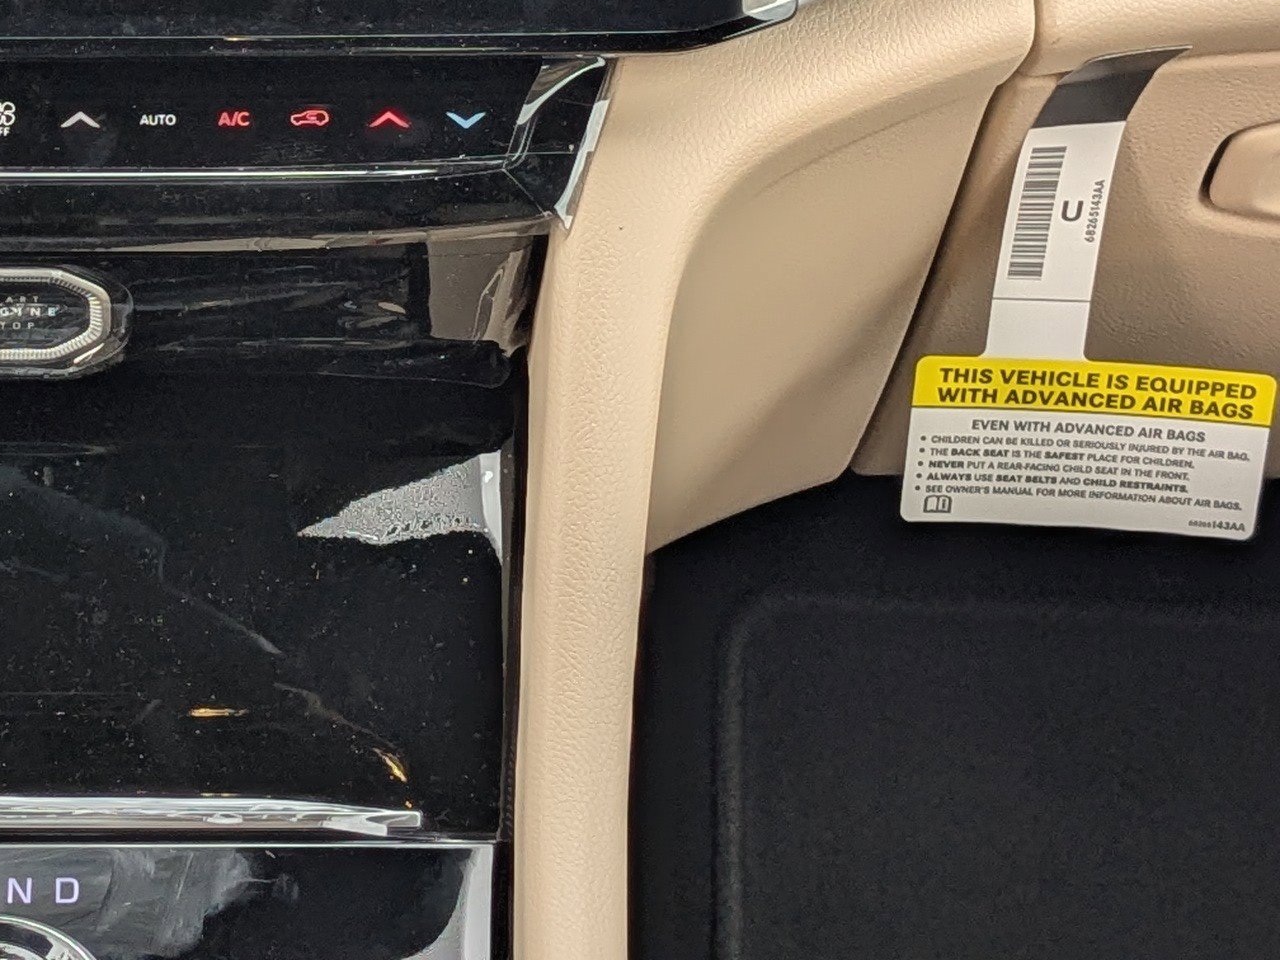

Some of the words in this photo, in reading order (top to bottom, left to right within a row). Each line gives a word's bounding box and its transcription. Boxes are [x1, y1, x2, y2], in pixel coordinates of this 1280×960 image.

[140, 113, 177, 126] AUTO
[219, 111, 250, 127] A/C
[939, 367, 993, 384] THIS
[1000, 369, 1101, 388] VEHICLE
[1106, 374, 1130, 390] IS
[1135, 376, 1257, 400] EQUIPPED
[937, 387, 998, 403] WITH
[1004, 390, 1136, 410] ADVANCED
[1141, 396, 1183, 414] AIR
[1189, 400, 1255, 420] BAGS
[971, 419, 1009, 431] EVEN
[1013, 420, 1051, 433] WITH
[1053, 422, 1135, 437] ADVANCED
[1137, 427, 1163, 440] AIR
[1166, 429, 1206, 442] BAGS
[930, 448, 948, 456] THE
[951, 448, 980, 457] BACK
[983, 449, 1009, 458] SEAT
[1012, 450, 1021, 458] IS
[1023, 450, 1042, 459] THE
[1044, 451, 1086, 461] SAFEST
[1087, 454, 1118, 463] PLACE
[1120, 455, 1140, 464] FOR
[931, 435, 980, 445] CHILDREN
[982, 436, 1003, 446] CAN
[1006, 437, 1018, 446] BE
[1021, 437, 1054, 447] KILLED
[1056, 438, 1070, 447] OR
[1073, 439, 1126, 451] SERIOUSLY
[1128, 443, 1170, 454] INJURED
[1172, 446, 1184, 455] BY
[1187, 447, 1206, 457] THE
[1208, 449, 1224, 459] AIR
[927, 472, 972, 482] ALWAYS
[974, 473, 993, 482] USE
[995, 474, 1022, 483] SEAT
[1024, 475, 1057, 484] BELTS
[1059, 477, 1081, 485] AND
[1083, 478, 1117, 487] CHILD
[928, 460, 964, 469] NEVER
[967, 461, 985, 470] PUT
[1062, 464, 1093, 473] CHILD
[1095, 466, 1119, 475] SEAT
[1121, 468, 1132, 476] IN
[1134, 468, 1153, 478] THE
[1155, 470, 1191, 481] FRONT.
[926, 485, 943, 494] SEE
[992, 486, 1033, 496] MANUAL
[1035, 487, 1056, 497] FOR
[1058, 489, 1087, 498] MORE
[1088, 490, 1156, 503] INFORMATION
[1158, 495, 1192, 506] ABOUT
[1193, 499, 1211, 508] AIR
[7, 877, 33, 904] N
[55, 877, 80, 904] D
